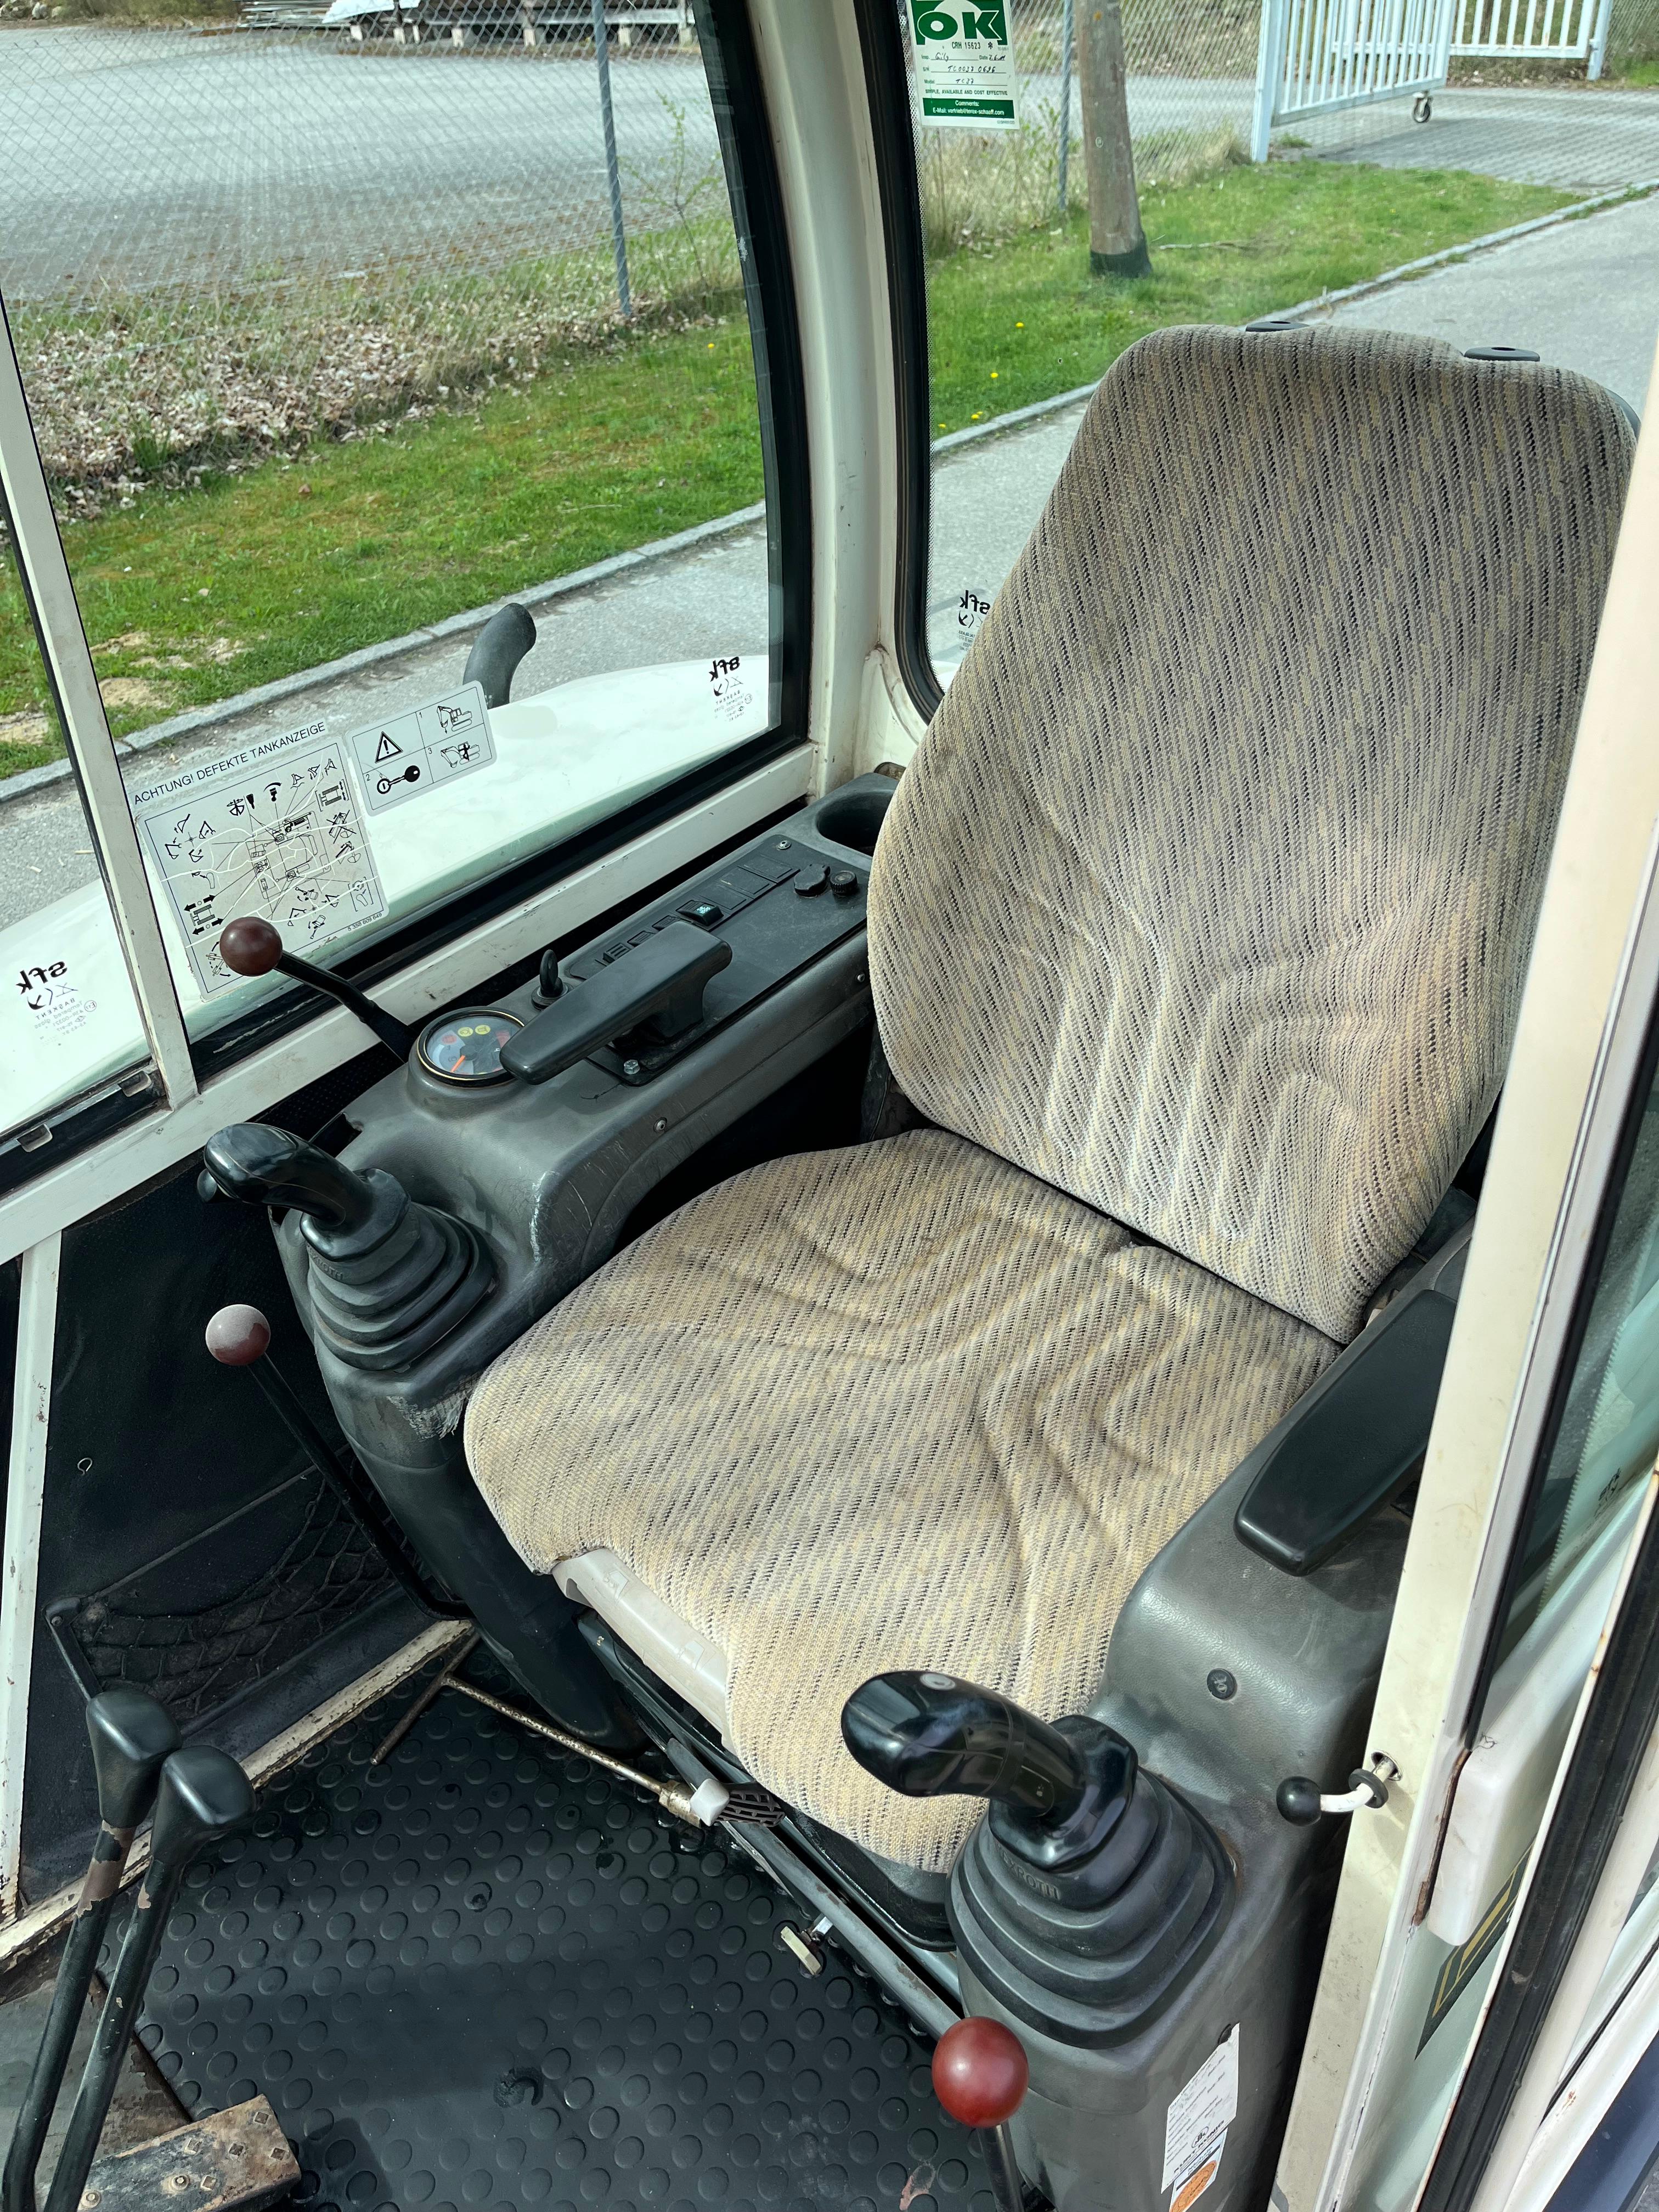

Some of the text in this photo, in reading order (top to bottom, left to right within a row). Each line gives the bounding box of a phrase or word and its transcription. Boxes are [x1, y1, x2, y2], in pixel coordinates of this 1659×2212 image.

[917, 10, 1002, 41] OK
[135, 722, 326, 805] ACHTUNG! DEFEKTE TANKANZEIGE
